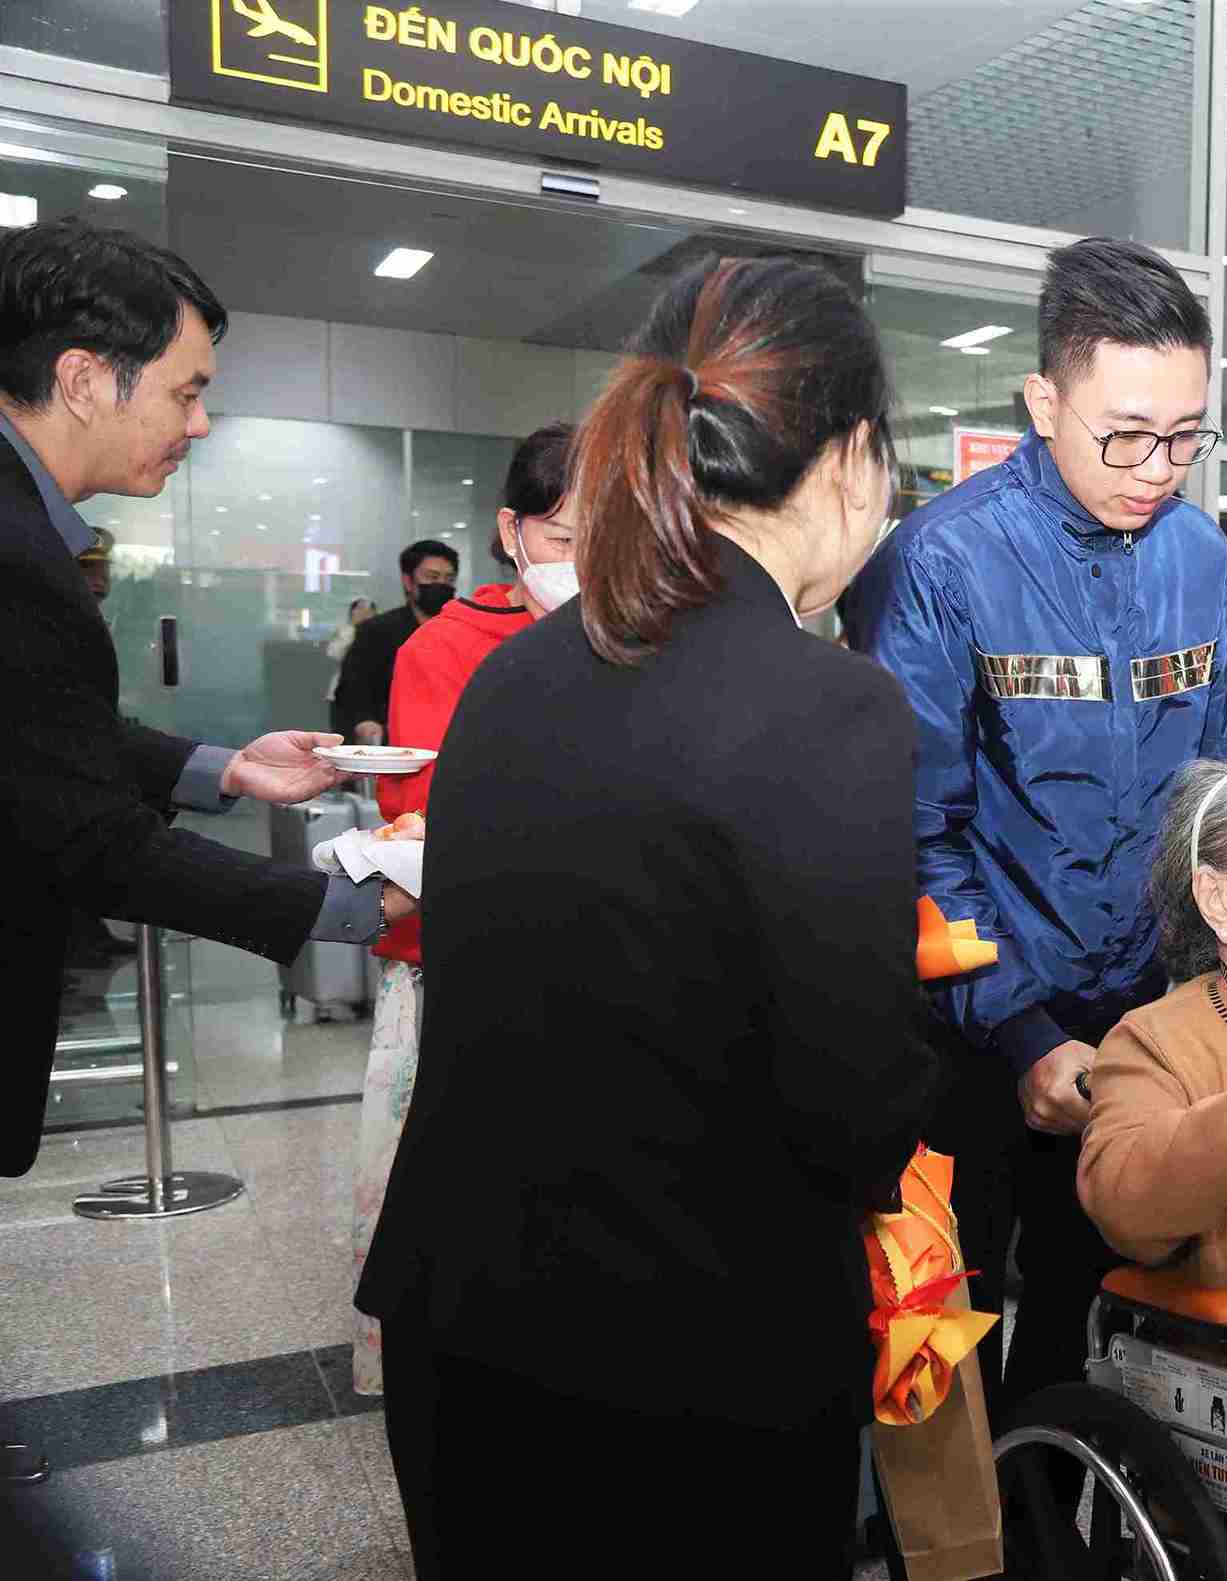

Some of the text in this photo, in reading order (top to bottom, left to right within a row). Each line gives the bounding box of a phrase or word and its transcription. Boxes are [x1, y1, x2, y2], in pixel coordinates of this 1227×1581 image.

[364, 5, 671, 99] ĐẾN QUỐC NỘI
[363, 67, 664, 150] Domestic Arrivals
[814, 111, 890, 167] A7
